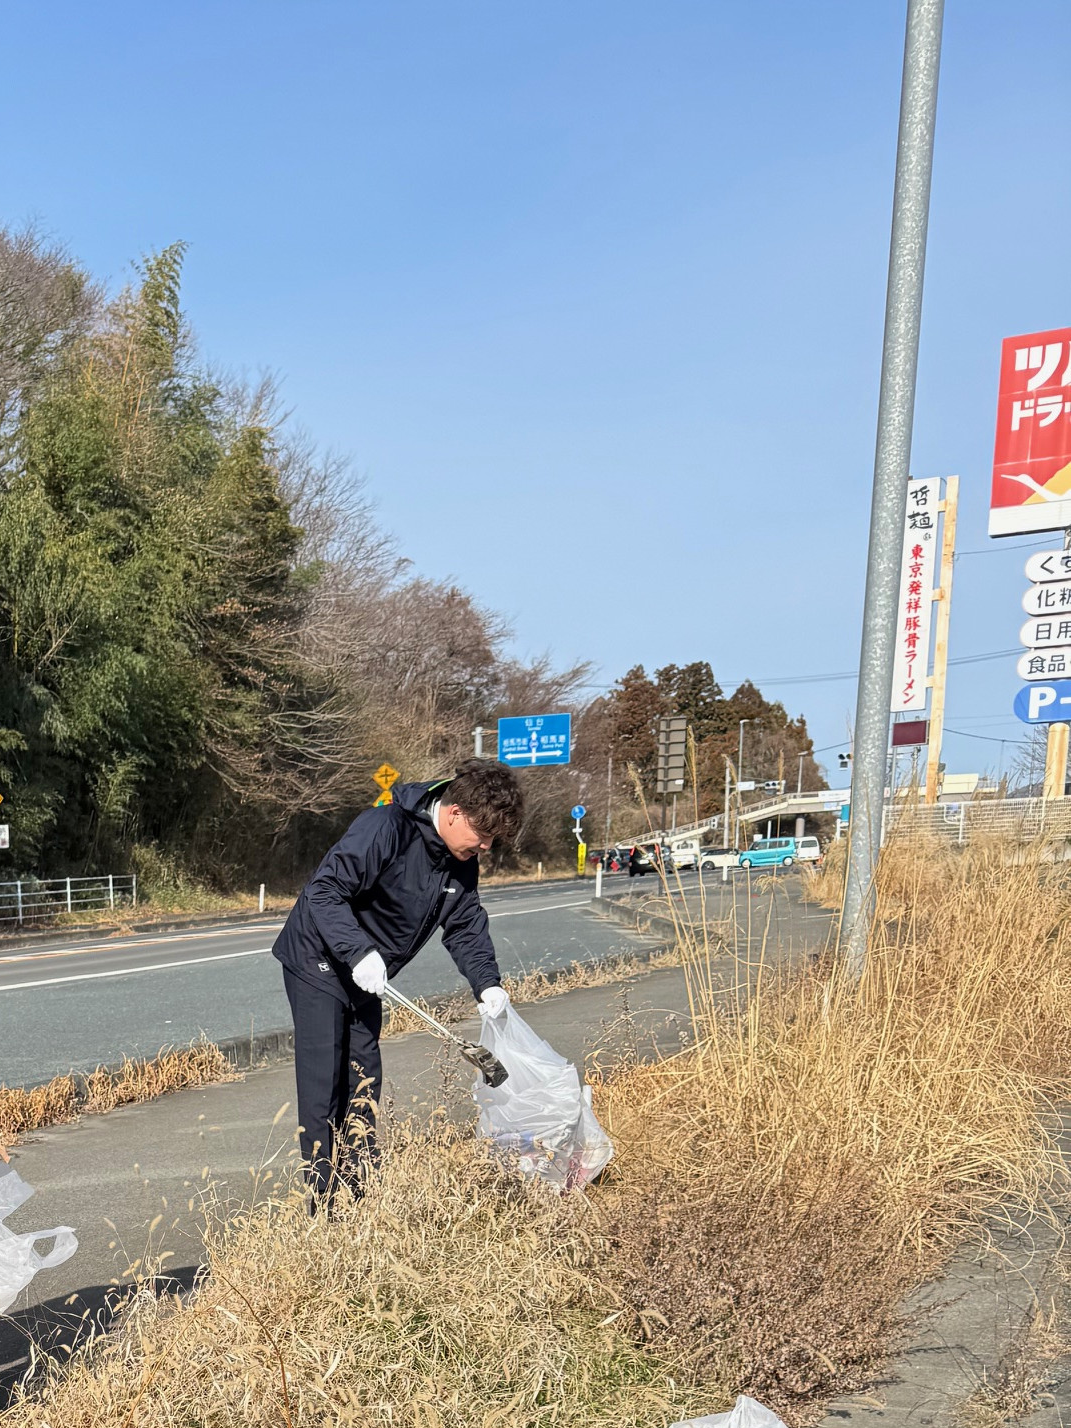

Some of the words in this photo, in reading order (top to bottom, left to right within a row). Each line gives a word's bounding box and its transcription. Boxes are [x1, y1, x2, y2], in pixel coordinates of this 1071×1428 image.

[1014, 341, 1071, 392] ツ
[902, 544, 925, 704] 東京発祥豚骨ラーメン
[1028, 686, 1057, 719] P
